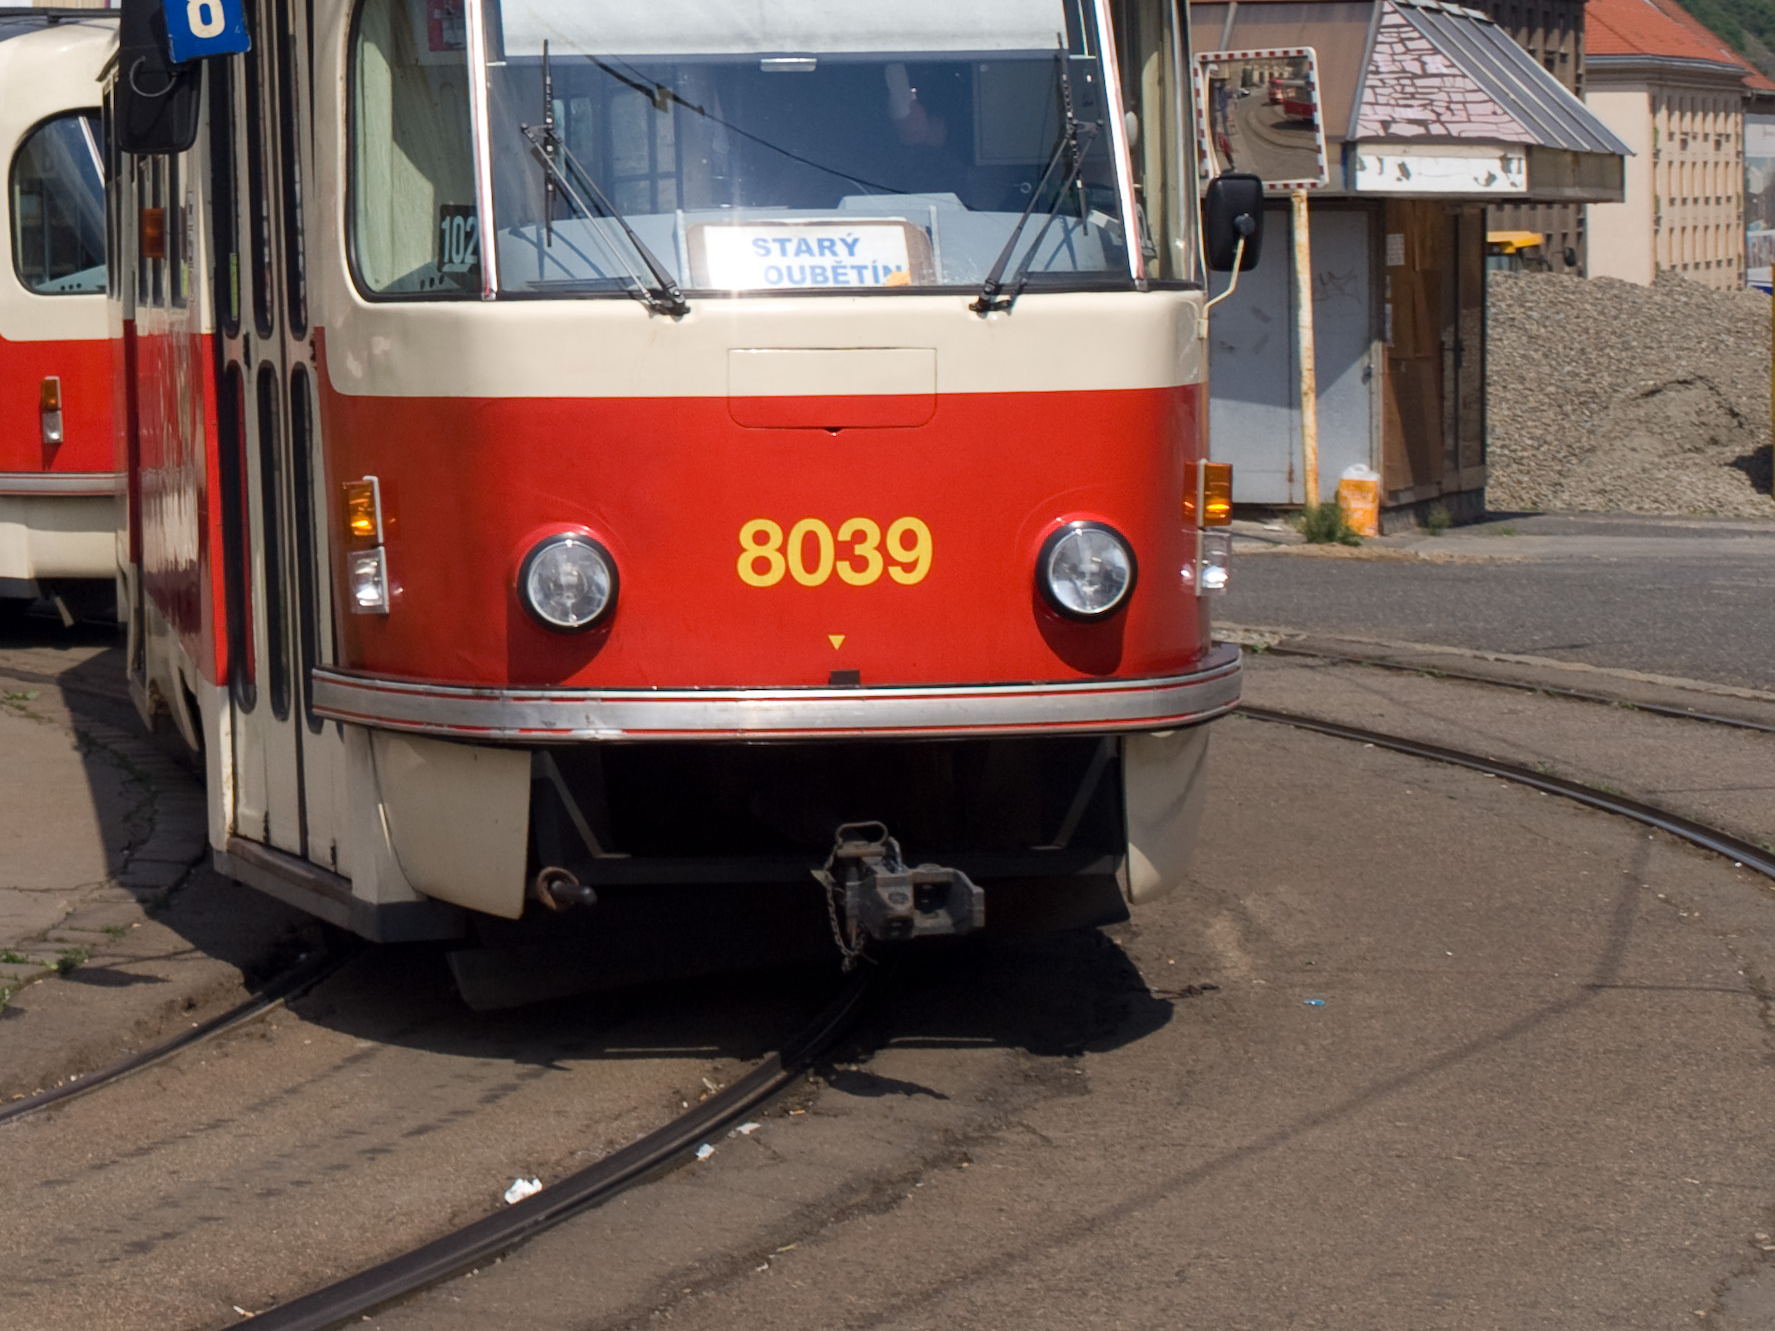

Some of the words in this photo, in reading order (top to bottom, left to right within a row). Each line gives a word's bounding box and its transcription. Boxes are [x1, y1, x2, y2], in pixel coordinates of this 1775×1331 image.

[441, 215, 479, 264] 102
[751, 233, 860, 258] STARÝ
[737, 516, 933, 588] 8039
